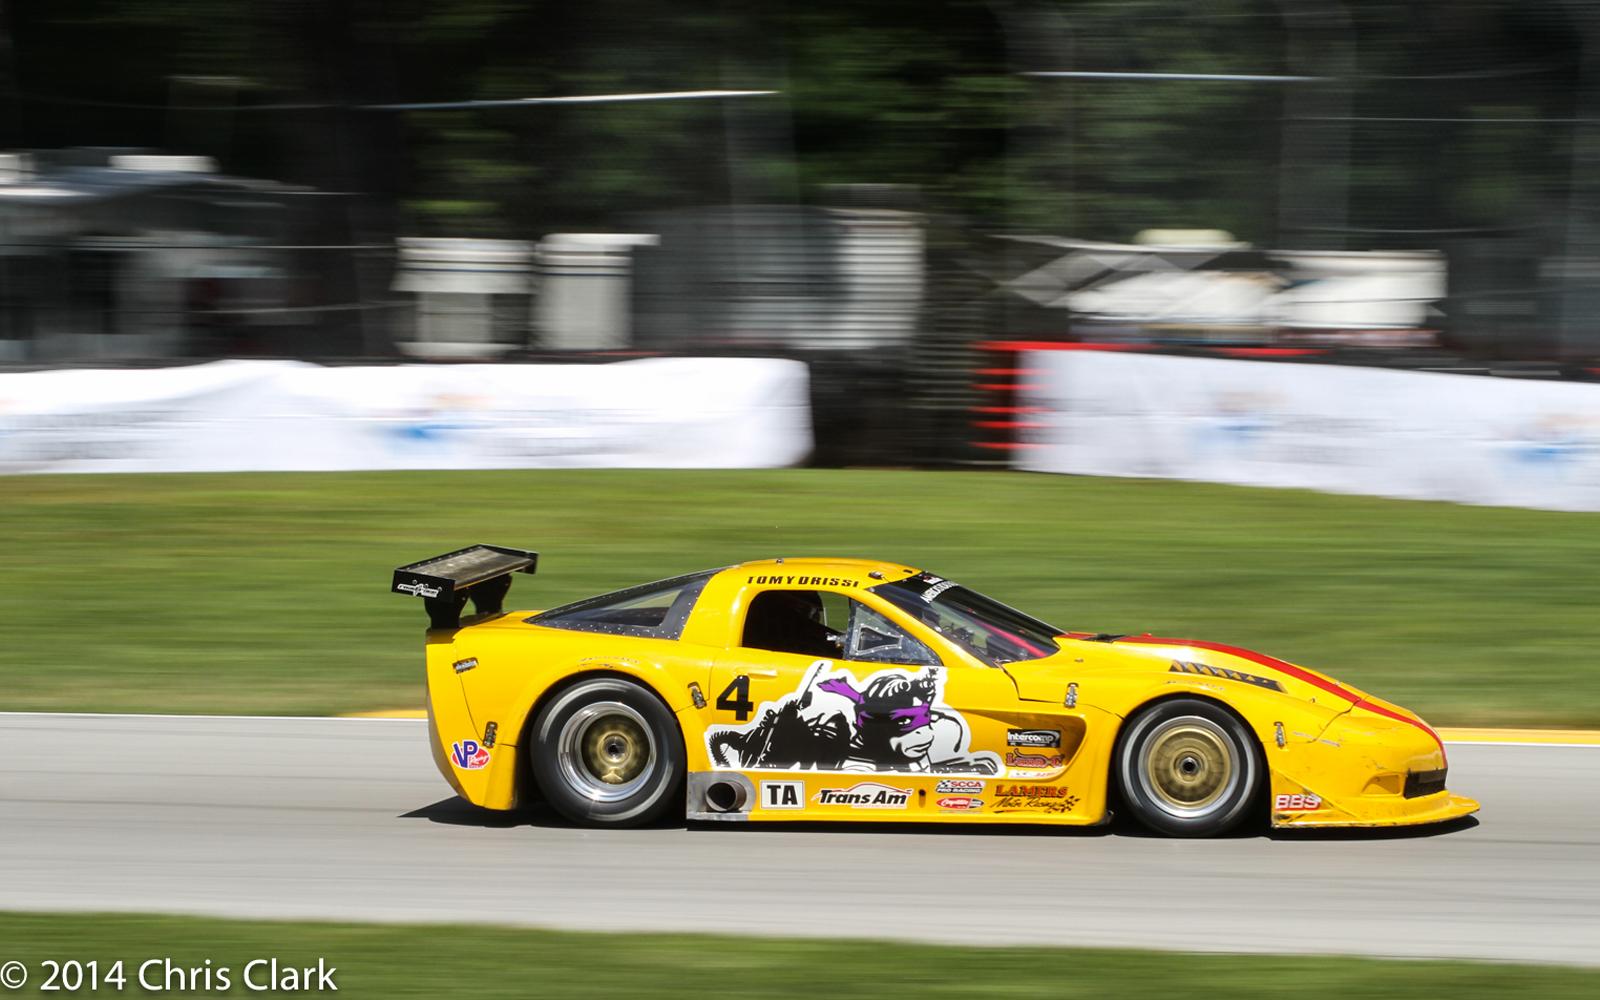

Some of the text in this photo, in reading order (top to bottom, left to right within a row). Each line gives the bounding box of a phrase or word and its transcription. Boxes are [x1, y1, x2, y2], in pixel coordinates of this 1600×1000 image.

[715, 674, 754, 721] 4
[453, 741, 479, 768] VP
[766, 785, 798, 805] TA
[820, 789, 907, 804] Trans Am
[994, 785, 1069, 798] LAMERS
[1275, 794, 1322, 809] BBS
